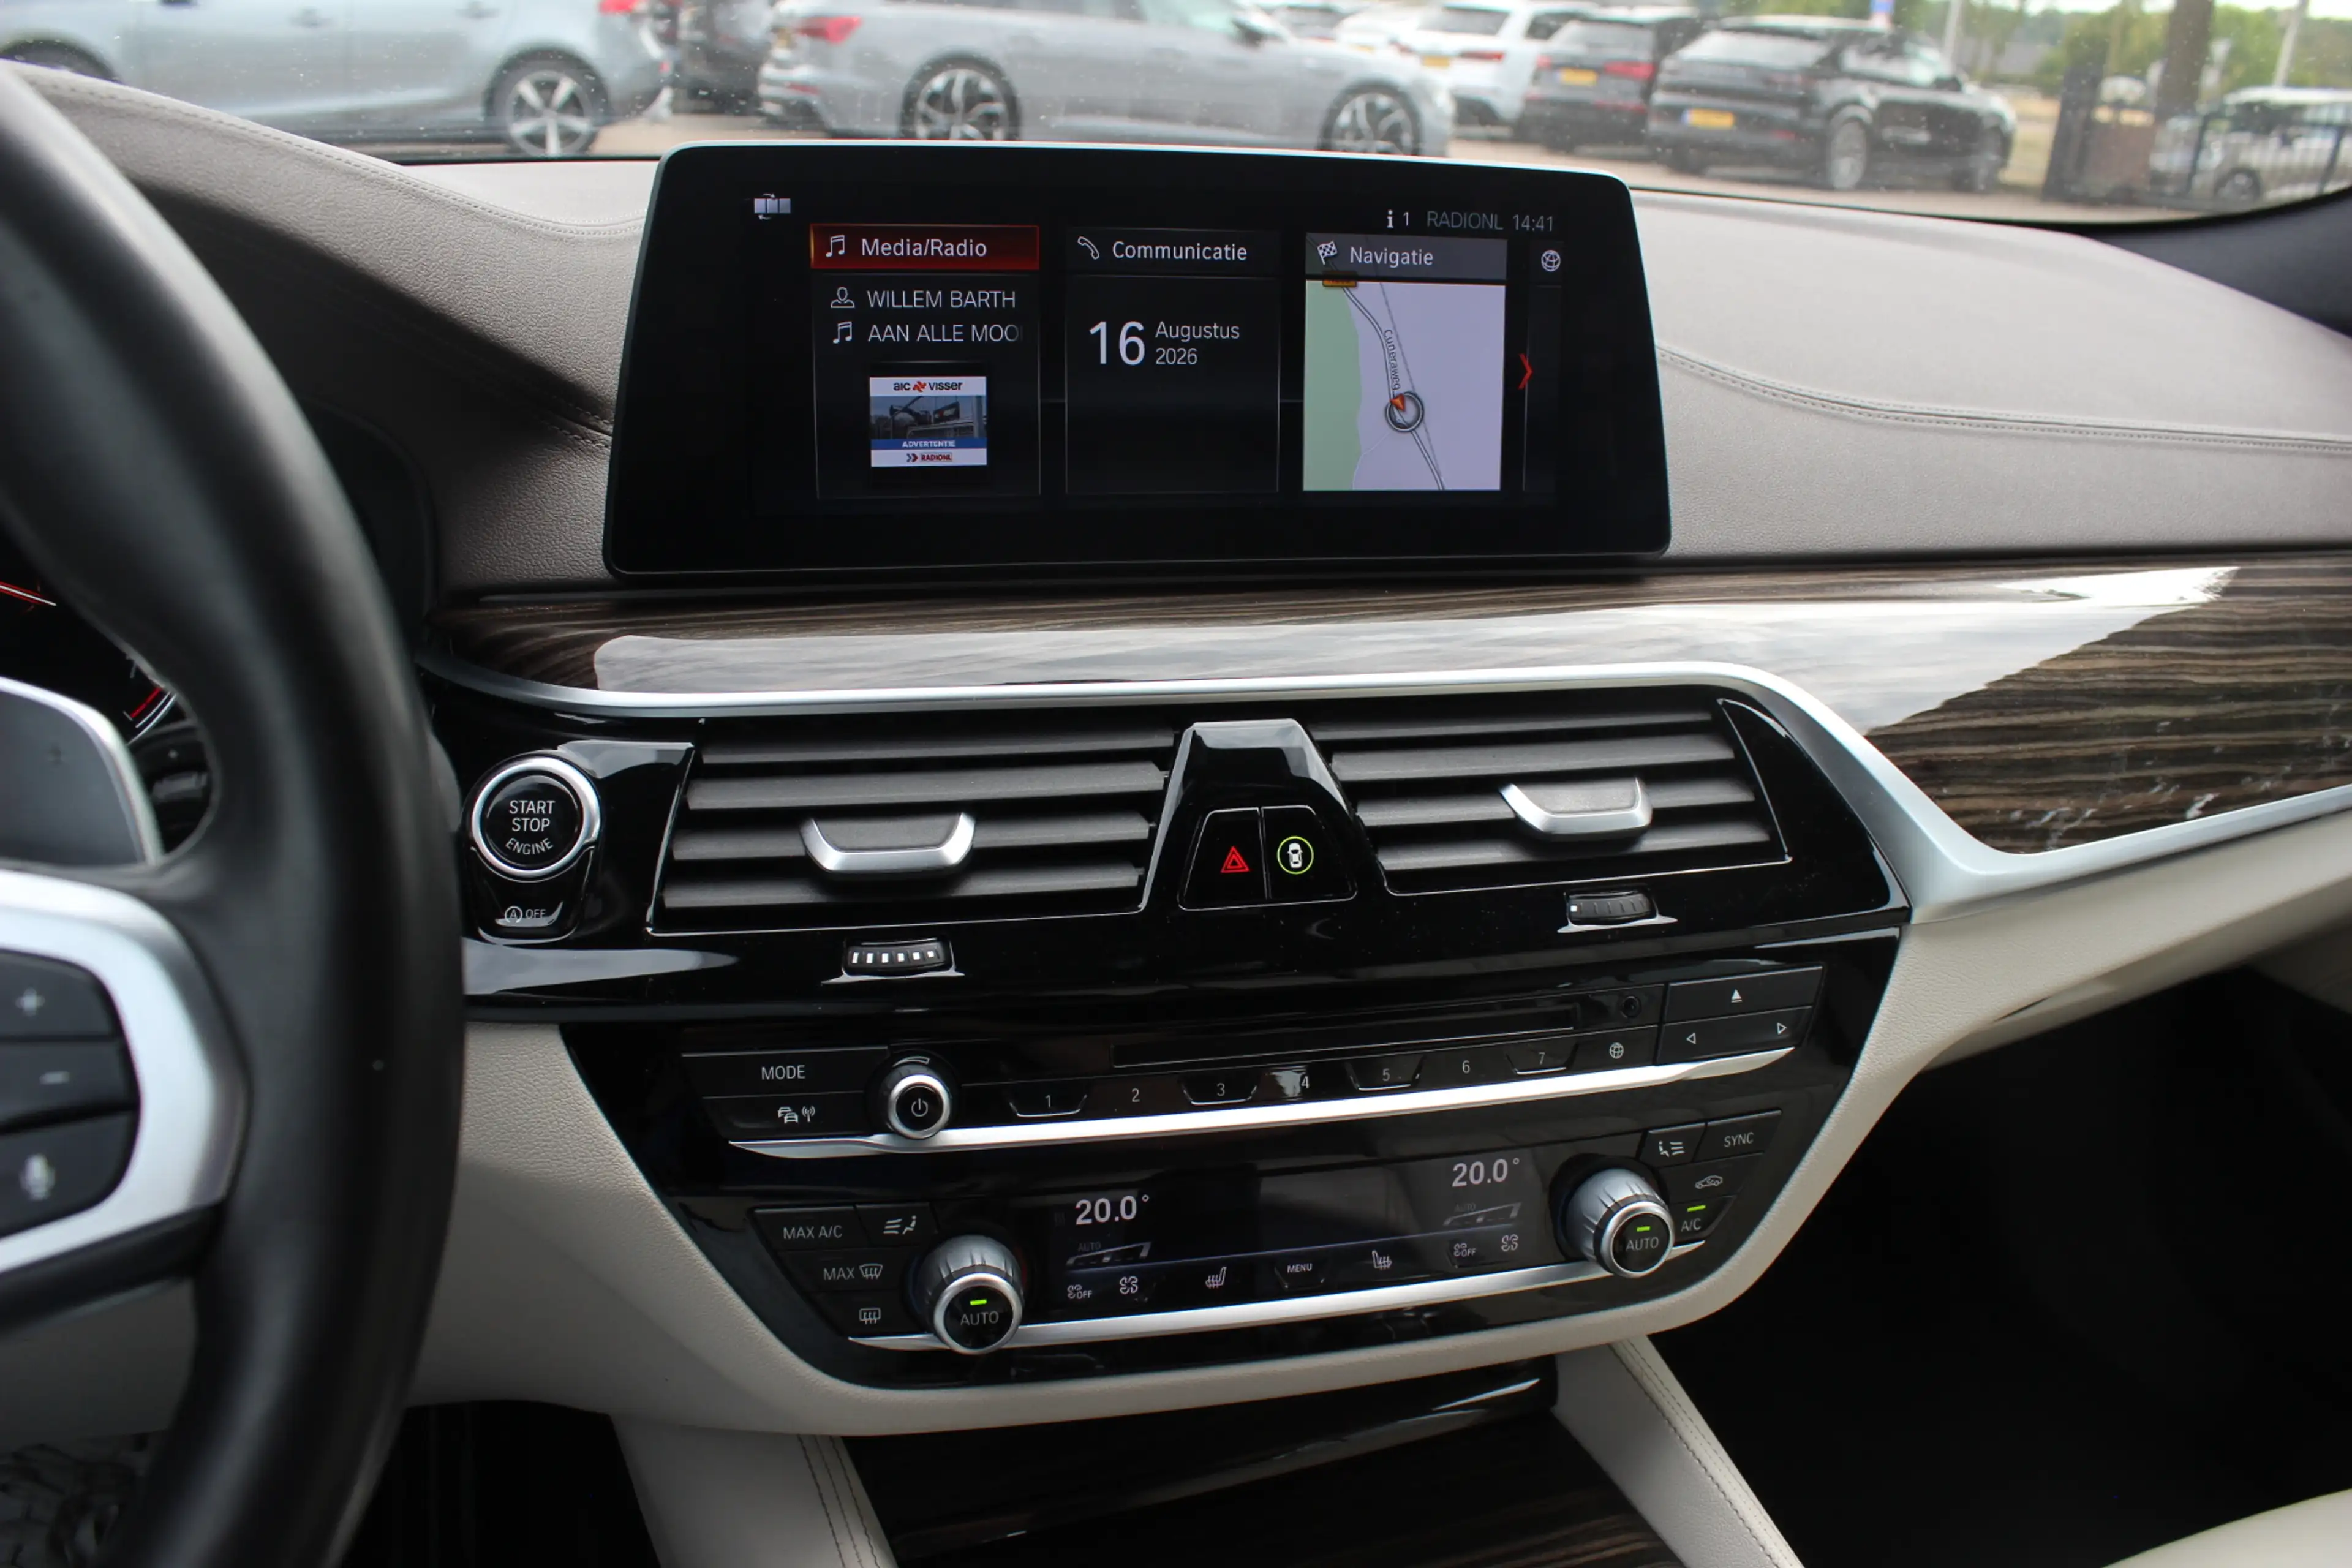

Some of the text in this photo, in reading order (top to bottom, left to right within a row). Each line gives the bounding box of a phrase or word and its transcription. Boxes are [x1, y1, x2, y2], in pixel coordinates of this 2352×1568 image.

[1427, 211, 1503, 230] RADIONL
[1513, 215, 1554, 232] 14:41
[862, 238, 987, 257] Media/Radio
[1112, 241, 1248, 260] Communicatie
[1350, 246, 1434, 268] Navigatie
[867, 290, 1017, 309] WILLEM BARTH
[868, 324, 1022, 342] AAN ALLE MOO
[1155, 321, 1240, 342] Augustus
[1089, 321, 1145, 366] 16
[1156, 347, 1198, 365] 2026
[1384, 329, 1401, 390] Cuneraweg
[509, 800, 555, 815] START
[511, 818, 550, 832] STOP
[505, 837, 553, 854] ENGINE
[526, 909, 546, 919] OFF
[1538, 1052, 1545, 1065] 7
[761, 1065, 806, 1080] MODE
[1461, 1060, 1471, 1074] 6
[1300, 1076, 1310, 1088] 4
[1382, 1069, 1390, 1082] 5
[1131, 1088, 1140, 1102] 2
[1216, 1084, 1226, 1096] 3
[1045, 1095, 1052, 1107] 1
[1724, 1133, 1754, 1148] SYNC
[783, 1225, 843, 1240] MAX A/C
[1681, 1218, 1702, 1232] A/C
[1626, 1237, 1659, 1251] AUTO
[1461, 1248, 1477, 1257] OFF
[823, 1267, 855, 1280] MAX
[1287, 1263, 1313, 1273] MENU
[1077, 1290, 1093, 1299] OFF
[960, 1311, 999, 1326] AUTO
